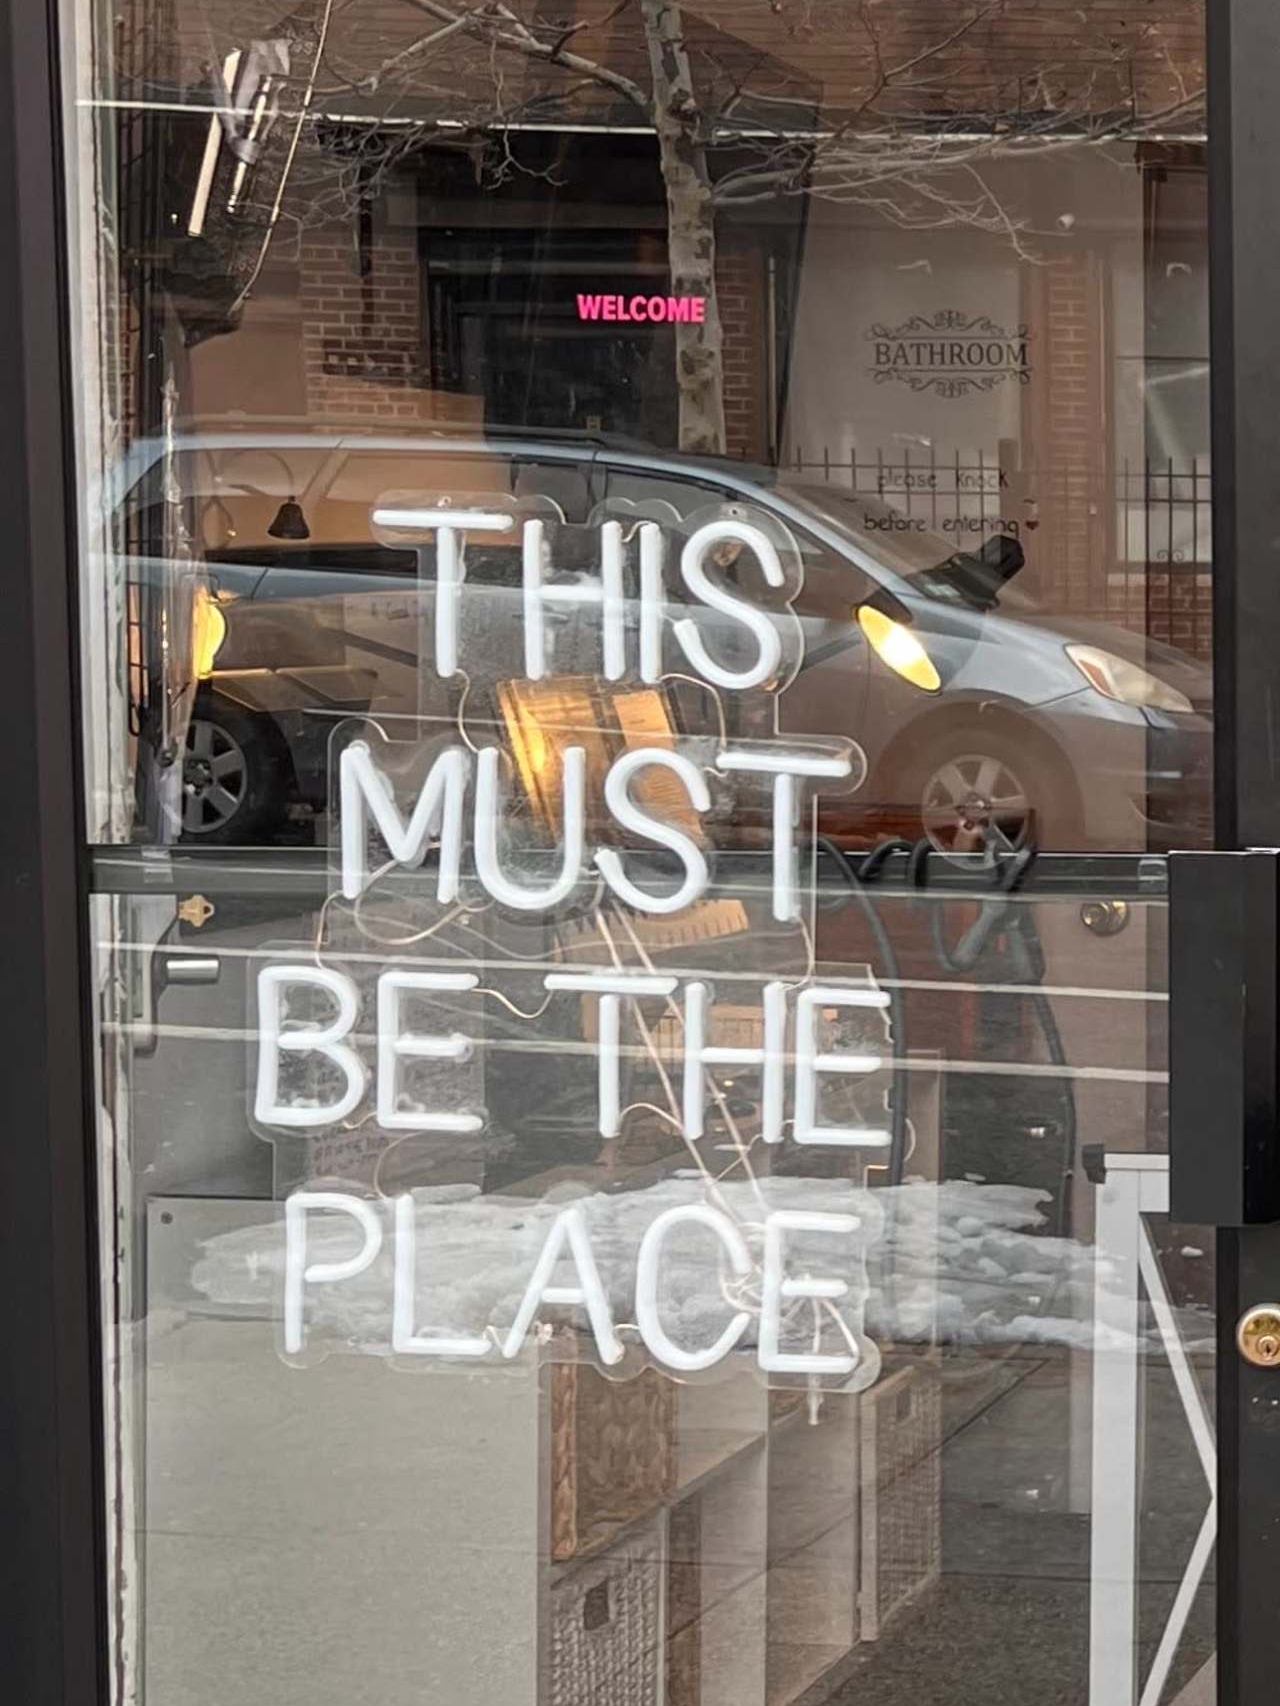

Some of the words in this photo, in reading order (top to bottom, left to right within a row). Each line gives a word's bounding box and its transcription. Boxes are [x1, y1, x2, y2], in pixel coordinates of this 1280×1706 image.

[576, 294, 706, 324] WELCOME
[875, 341, 1029, 367] BATHROOM
[373, 509, 785, 690] THIS
[864, 510, 927, 532] before
[942, 515, 1020, 539] entering
[340, 741, 851, 922] MUST
[254, 966, 484, 1131] BE
[544, 973, 893, 1146] THE
[283, 1192, 862, 1374] PLACE
